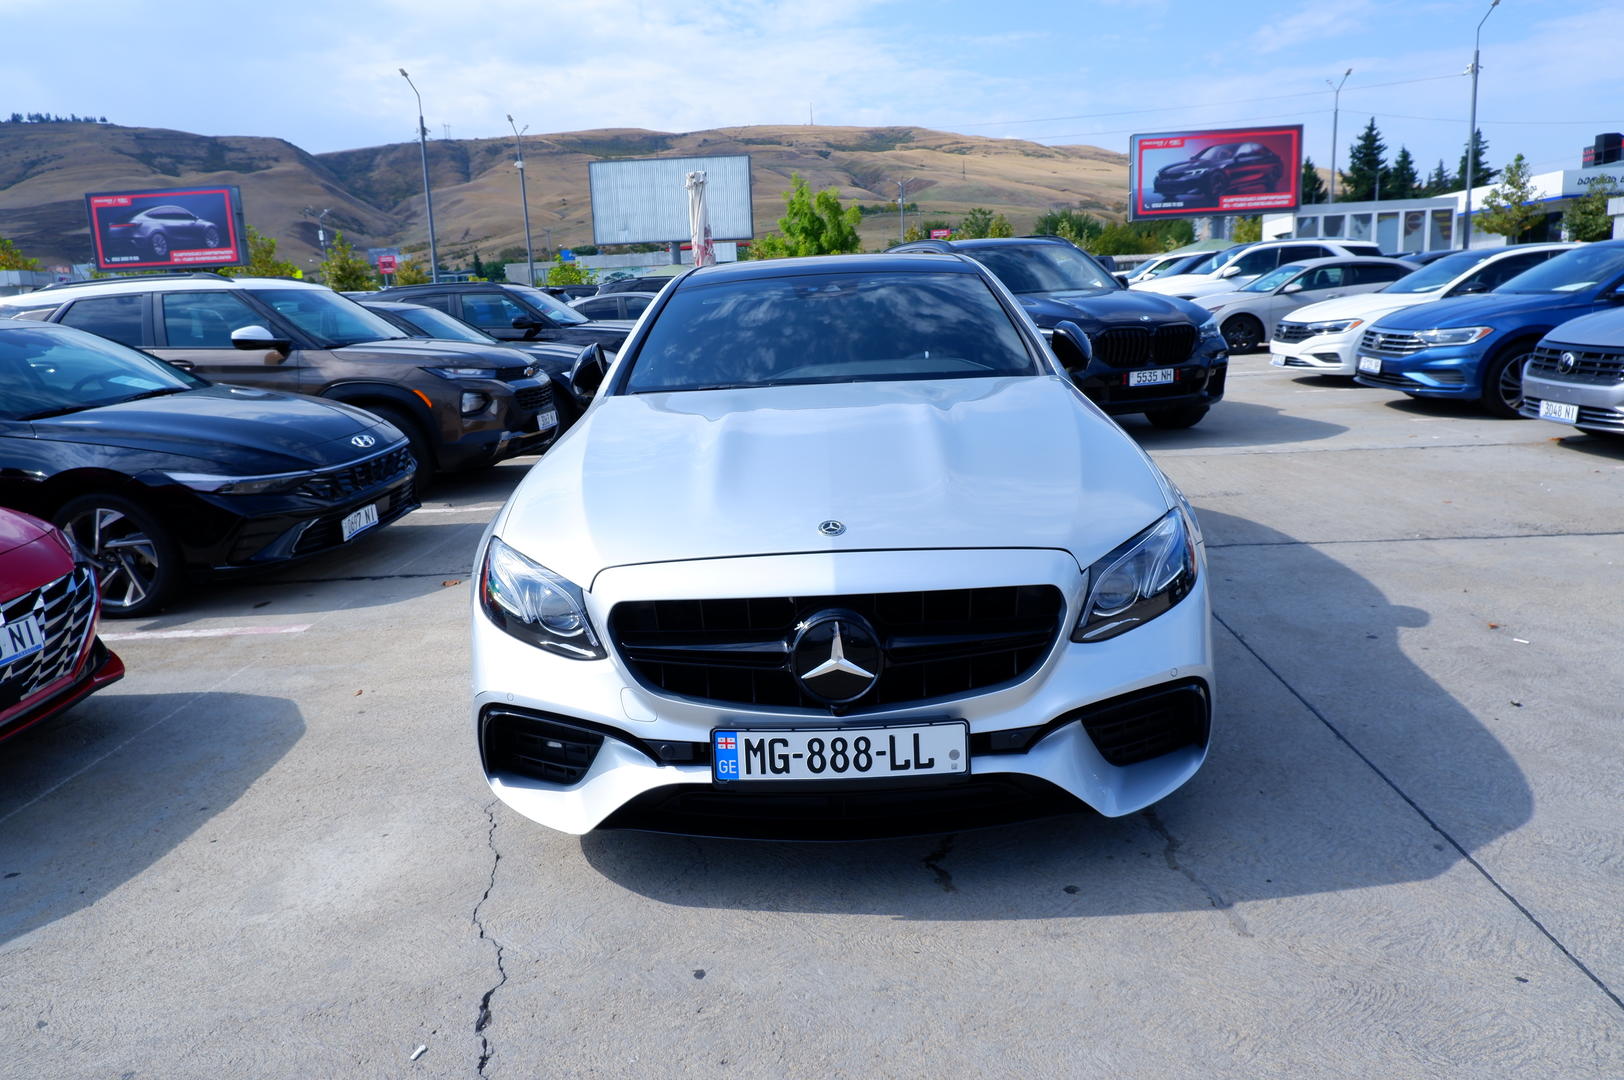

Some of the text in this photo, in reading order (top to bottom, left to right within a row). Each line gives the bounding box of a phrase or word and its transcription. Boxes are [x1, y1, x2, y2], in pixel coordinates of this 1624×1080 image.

[1136, 369, 1172, 383] 5535 NH
[364, 506, 375, 525] NI
[8, 620, 35, 653] NI
[744, 733, 935, 775] MG-888-LL
[719, 760, 737, 774] GE
